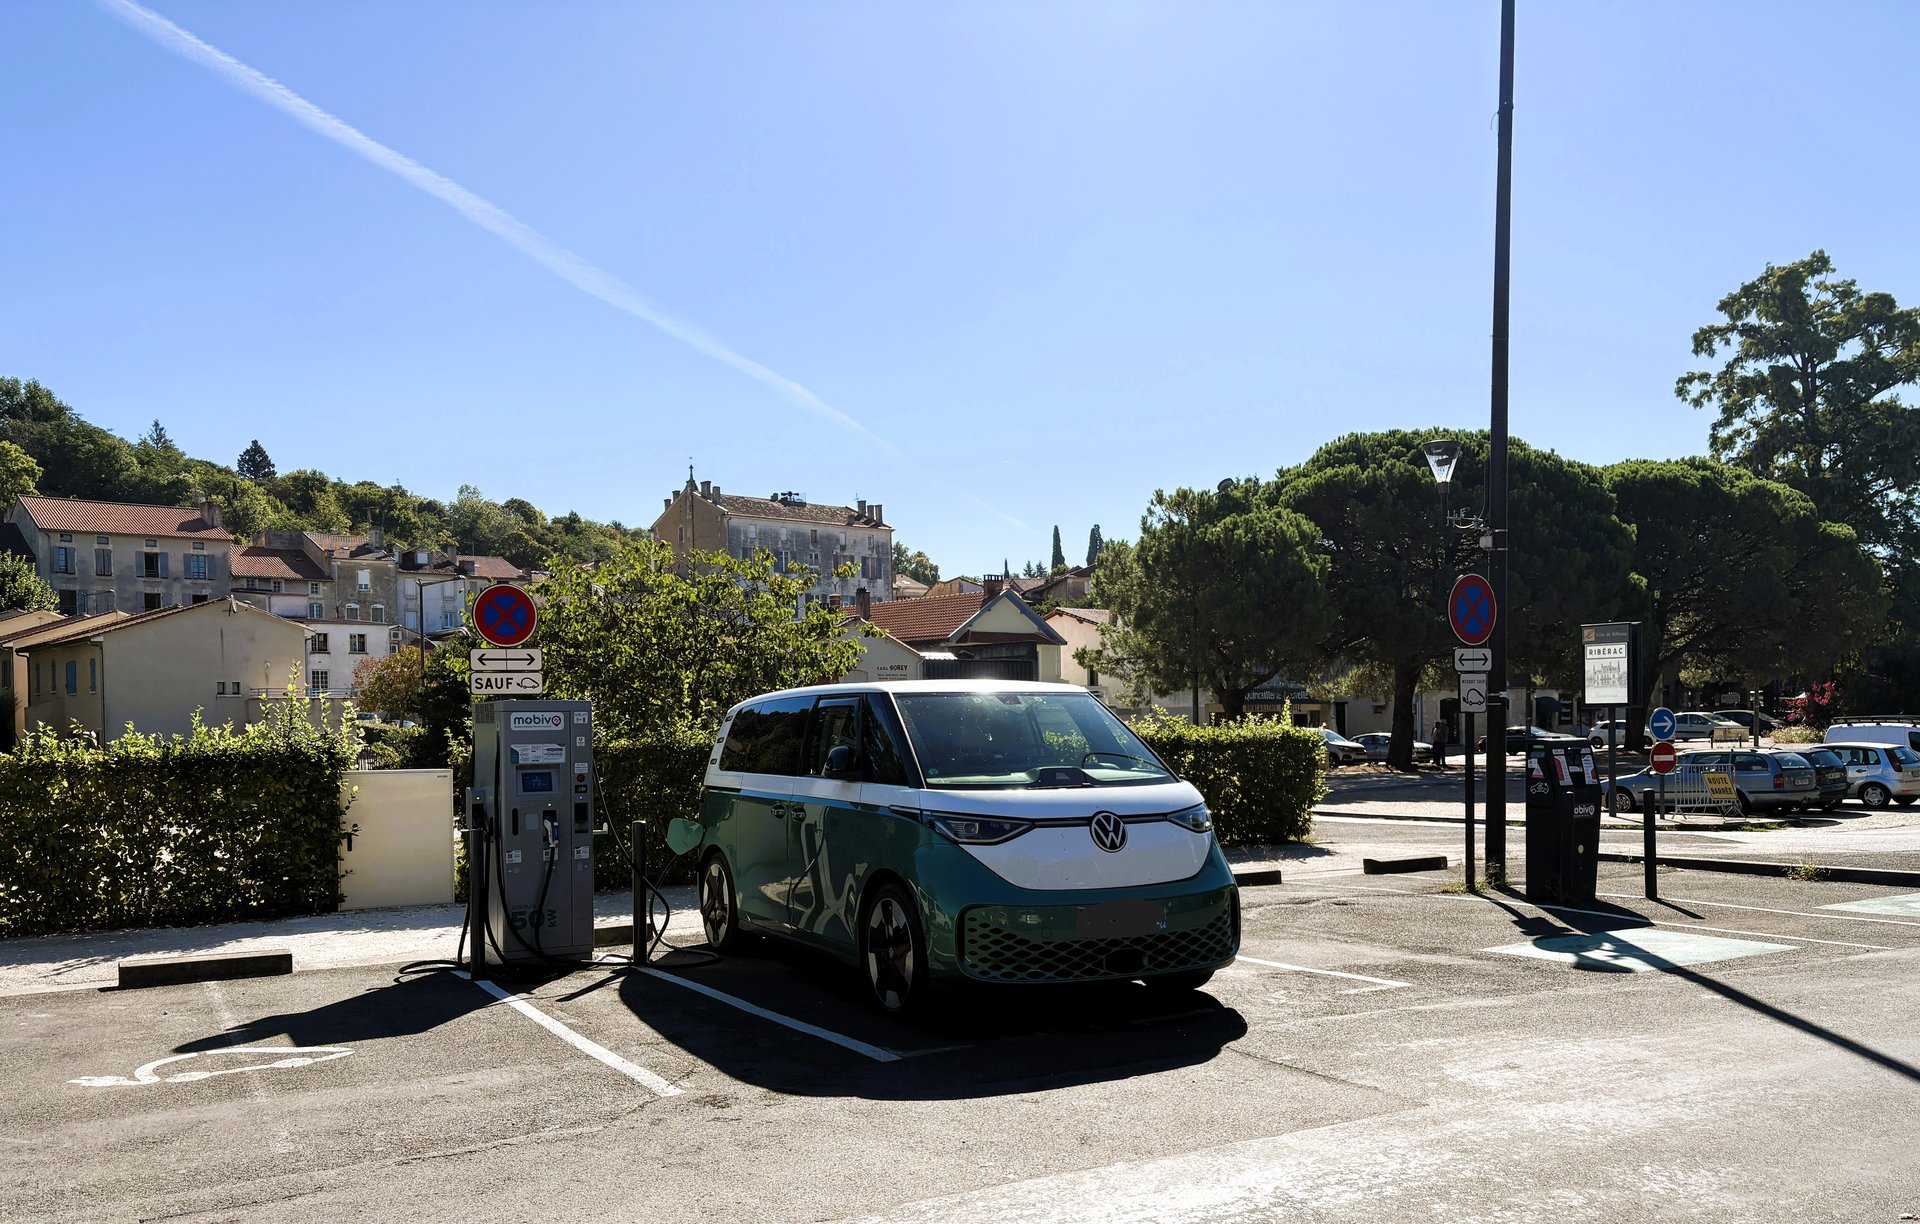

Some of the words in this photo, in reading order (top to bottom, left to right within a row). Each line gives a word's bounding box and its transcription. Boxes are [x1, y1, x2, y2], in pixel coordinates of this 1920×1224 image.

[1588, 647, 1623, 656] RIBÉRAC
[474, 677, 514, 690] SAUF
[1707, 777, 1729, 785] ROUTE
[1710, 786, 1733, 795] BARRÉE
[511, 910, 545, 930] 50
